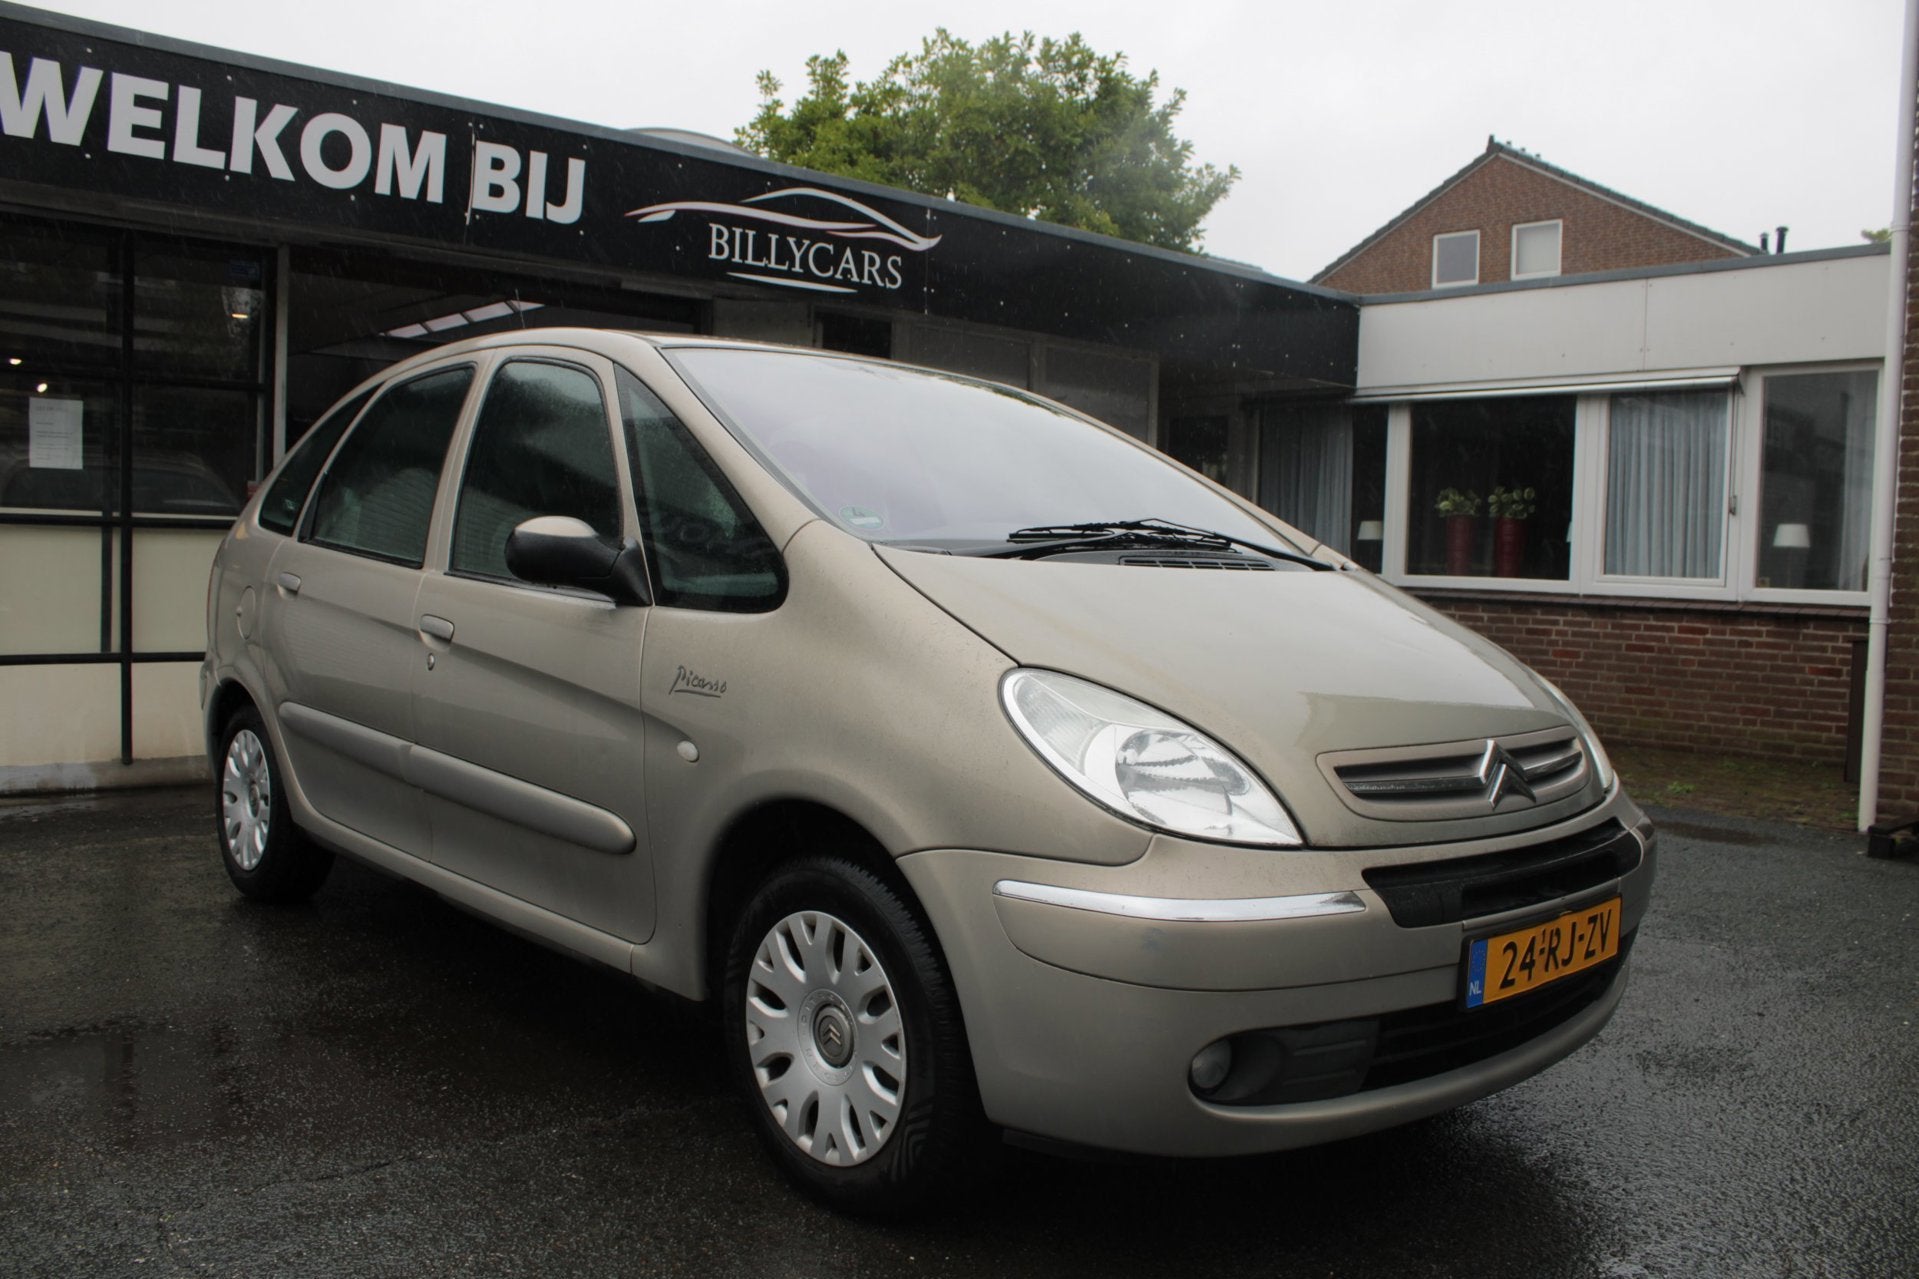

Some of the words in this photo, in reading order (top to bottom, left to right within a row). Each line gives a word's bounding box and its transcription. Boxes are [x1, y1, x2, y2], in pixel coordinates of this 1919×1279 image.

[0, 51, 447, 204] WELKOM
[471, 141, 586, 224] BIJ
[708, 223, 903, 290] BILLYCARS
[668, 665, 727, 697] Picasso
[1499, 908, 1612, 990] 24-RJ-ZV
[1468, 981, 1482, 997] NL
